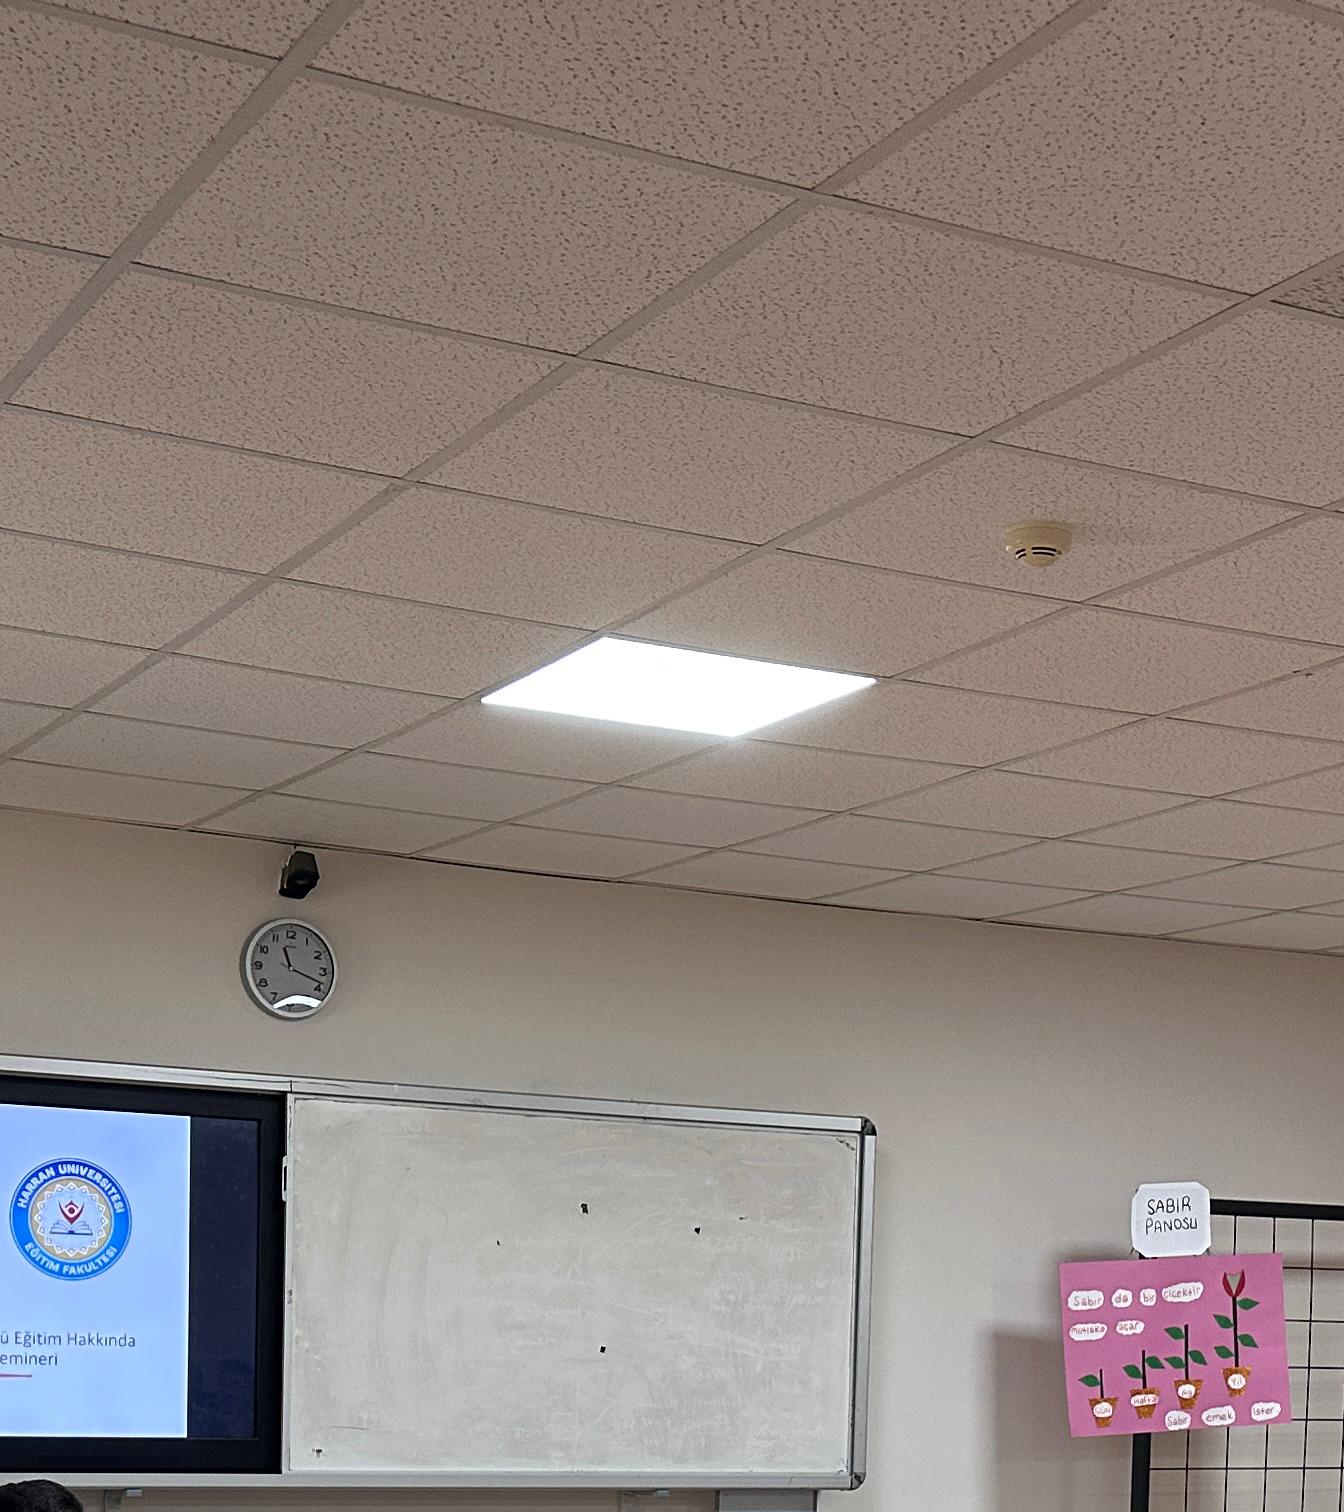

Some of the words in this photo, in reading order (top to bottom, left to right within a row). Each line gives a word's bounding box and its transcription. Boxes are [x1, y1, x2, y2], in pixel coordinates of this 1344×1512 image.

[272, 933, 279, 943] 11
[286, 930, 296, 940] 12
[259, 945, 269, 954] 10
[314, 950, 323, 960] 2
[254, 961, 263, 970] 9
[319, 967, 328, 977] 3
[258, 978, 269, 988] 8
[313, 983, 322, 993] 4
[270, 991, 278, 1001] 7
[17, 1166, 56, 1209] HARRAN
[1147, 1195, 1192, 1215] SABIR
[1145, 1217, 1198, 1235] PANOSU
[14, 1331, 62, 1348] Eğitim
[67, 1332, 136, 1348] Hakkında
